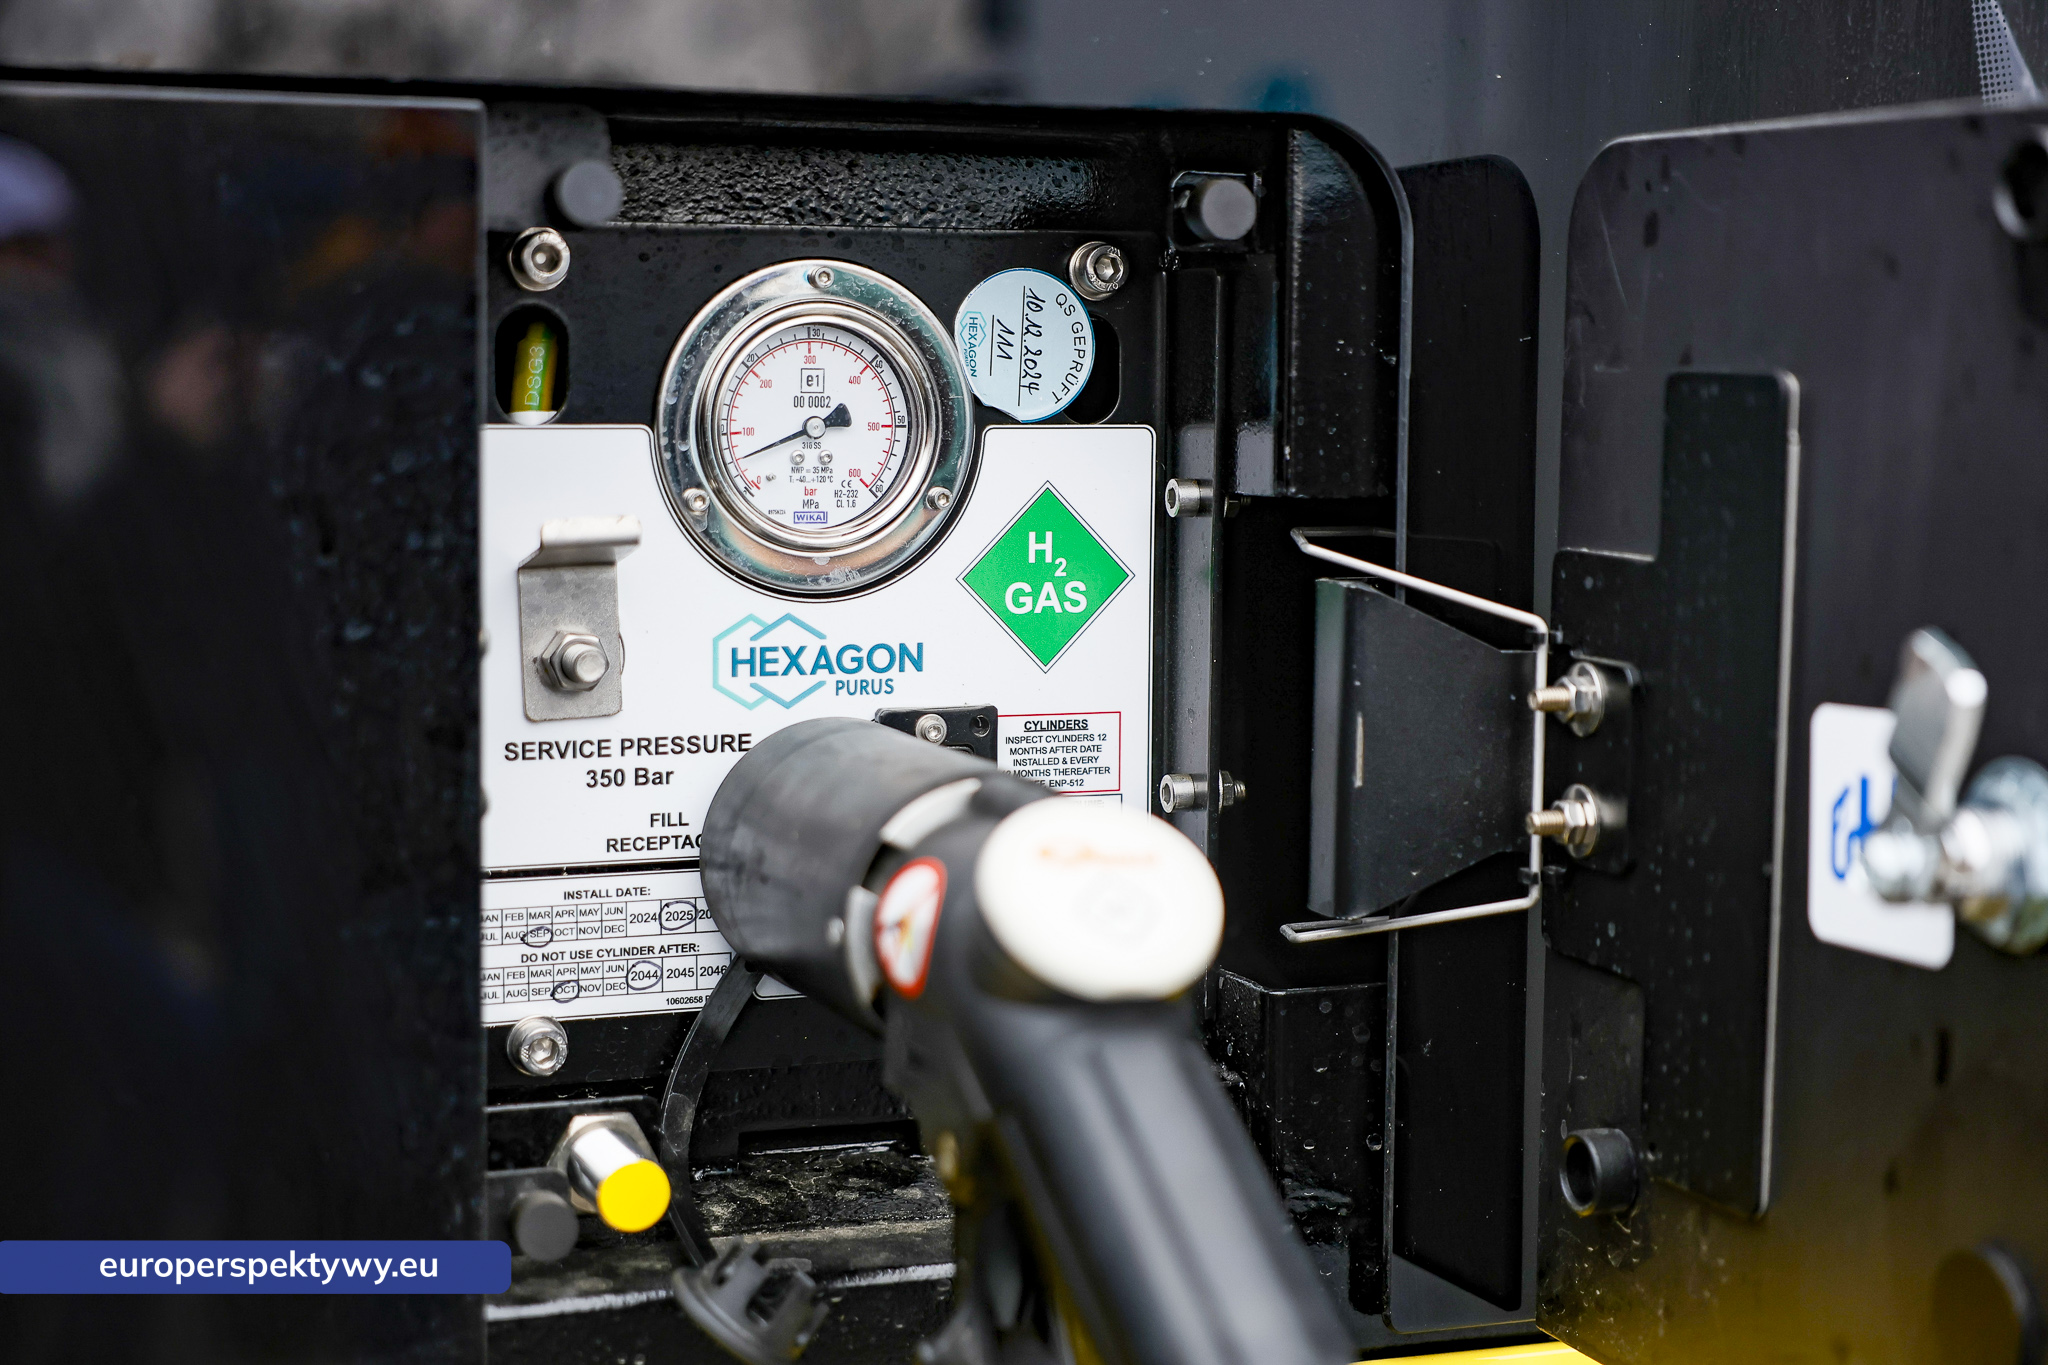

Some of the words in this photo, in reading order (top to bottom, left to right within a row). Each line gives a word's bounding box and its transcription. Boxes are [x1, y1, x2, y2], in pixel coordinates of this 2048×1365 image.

[1055, 293, 1076, 317] QS
[812, 329, 821, 338] 30
[967, 316, 979, 378] HEXAGON
[747, 354, 755, 363] 20
[804, 356, 817, 365] 300
[1052, 321, 1087, 405] GEPRÜFT
[875, 360, 884, 369] 40
[524, 346, 545, 406] DSG3
[806, 374, 820, 387] e1
[849, 376, 862, 385] 400
[759, 379, 773, 389] 200
[897, 416, 906, 424] 50
[867, 421, 881, 431] 500
[742, 427, 755, 437] 100
[812, 466, 820, 474] 35
[821, 466, 833, 474] MPa
[848, 468, 862, 478] 600
[804, 485, 818, 496] bar
[834, 489, 859, 498] H2-232
[875, 484, 884, 493] 60
[802, 499, 820, 509] MPa
[847, 500, 857, 508] 1.6
[796, 513, 823, 521] WIKA
[1005, 580, 1088, 615] GAS
[731, 642, 924, 678] HEXAGON
[836, 678, 895, 696] PURUS
[1024, 719, 1089, 731] CYLINDERS
[1005, 735, 1043, 744] INSPECT
[1045, 734, 1095, 743] CYLINDERS
[1098, 733, 1107, 742] 12
[504, 738, 612, 761] SERVICE
[620, 733, 752, 757] PRESSURE
[1009, 746, 1048, 755] MONTHS
[1049, 745, 1078, 754] AFTER
[1080, 744, 1102, 753] DATE
[1013, 757, 1060, 766] INSTALLED
[1061, 757, 1068, 765] &
[1070, 756, 1099, 764] EVERY
[1054, 767, 1111, 776] THEREAFTER
[586, 768, 626, 788] 350
[634, 767, 675, 787] Bar
[1049, 779, 1084, 788] ENP-512
[649, 812, 690, 828] FILL
[563, 888, 613, 900] INSTALL
[616, 887, 651, 898] DATE:
[505, 913, 524, 921] FEB
[529, 911, 551, 920] MAR
[554, 909, 576, 919] APR
[579, 908, 599, 917] MAY
[604, 906, 624, 916] JUN
[629, 912, 658, 924] 2024
[665, 910, 693, 922] 2025
[529, 928, 550, 938] SEP
[554, 927, 575, 937] OCT
[579, 925, 600, 935] NOV
[604, 924, 625, 934] DEC
[521, 953, 538, 963] DO
[541, 951, 566, 962] NOT
[569, 949, 593, 960] USE
[596, 946, 655, 959] CYLINDER
[658, 943, 700, 954] AFTER:
[506, 970, 526, 979] FEB
[530, 968, 552, 978] MAR
[555, 967, 577, 977] APR
[580, 965, 601, 975] MAY
[605, 964, 625, 974] JUN
[630, 970, 659, 981] 2044
[666, 967, 695, 979] 2045
[700, 965, 728, 976] 2046
[506, 988, 528, 998] AUG
[531, 987, 551, 996] SEP
[555, 985, 577, 995] OCT
[580, 983, 602, 993] NOV
[605, 981, 626, 991] DEC
[666, 996, 704, 1005] 10602658
